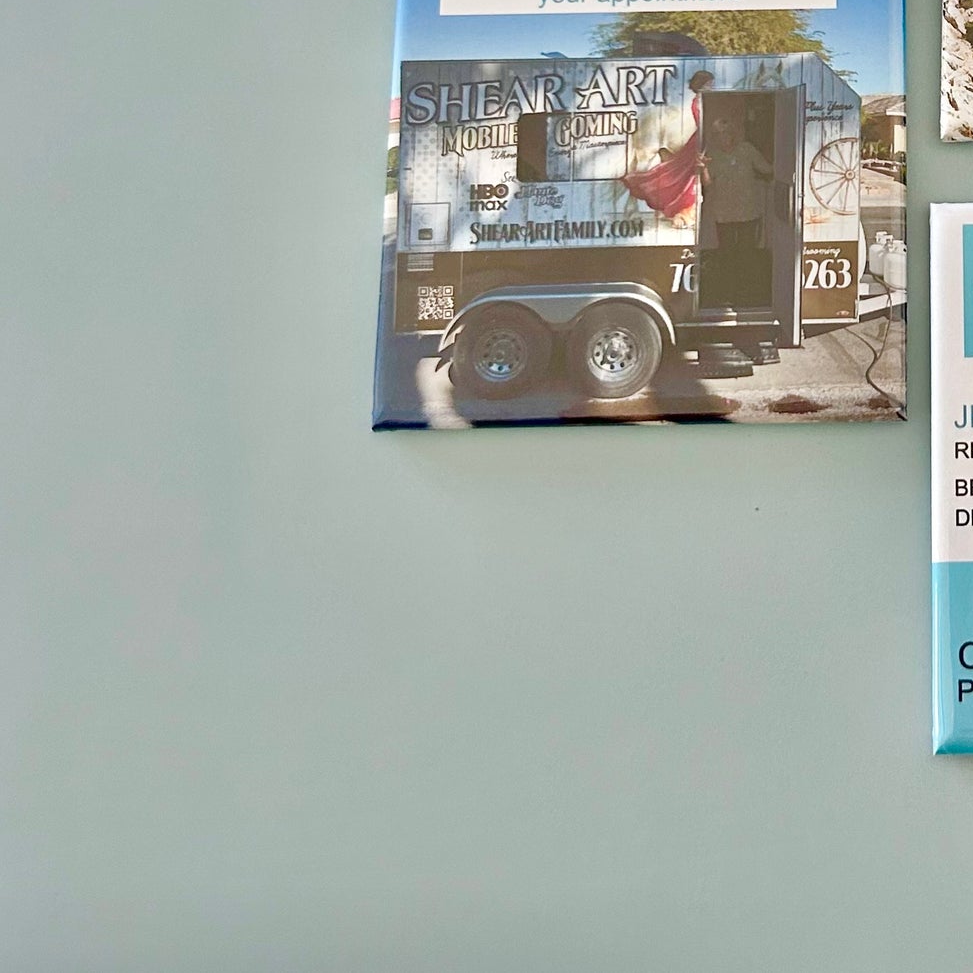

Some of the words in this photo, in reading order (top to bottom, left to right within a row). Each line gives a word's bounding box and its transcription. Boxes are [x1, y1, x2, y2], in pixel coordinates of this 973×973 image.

[405, 74, 566, 125] SHEAR
[577, 65, 676, 109] ART
[441, 123, 518, 157] MOBILE
[470, 184, 509, 199] HBO
[470, 200, 507, 211] max
[803, 259, 851, 289] 263
